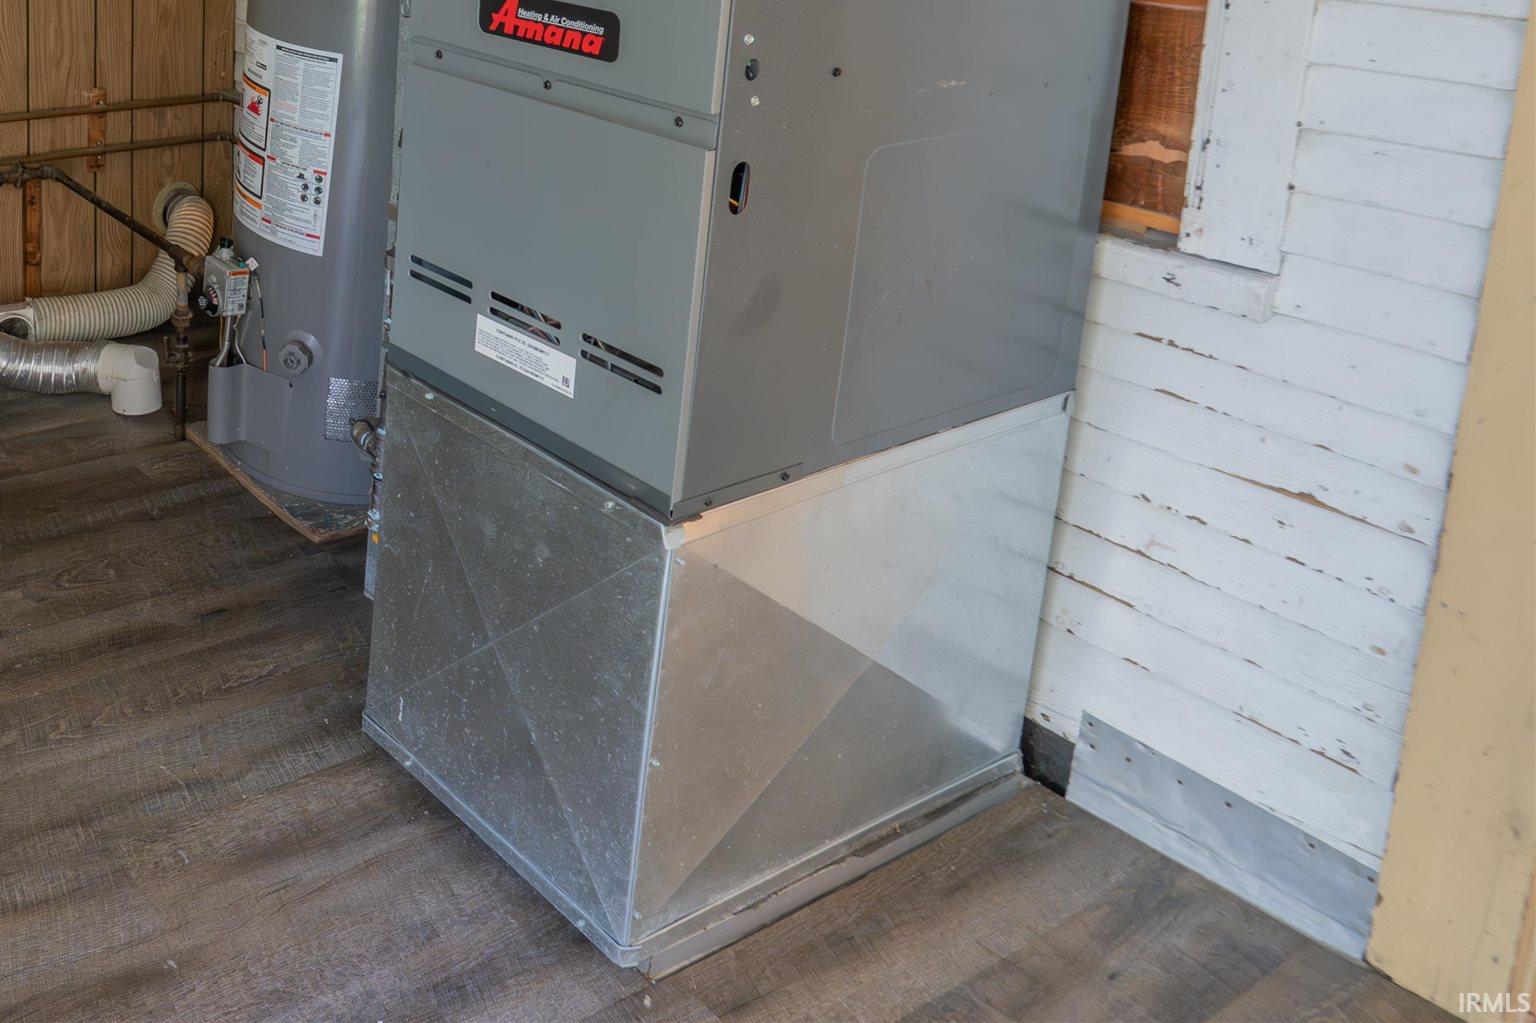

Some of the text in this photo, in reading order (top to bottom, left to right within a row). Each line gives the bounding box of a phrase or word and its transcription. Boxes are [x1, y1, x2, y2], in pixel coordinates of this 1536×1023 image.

[517, 7, 605, 35] Heating & Air Conditioning
